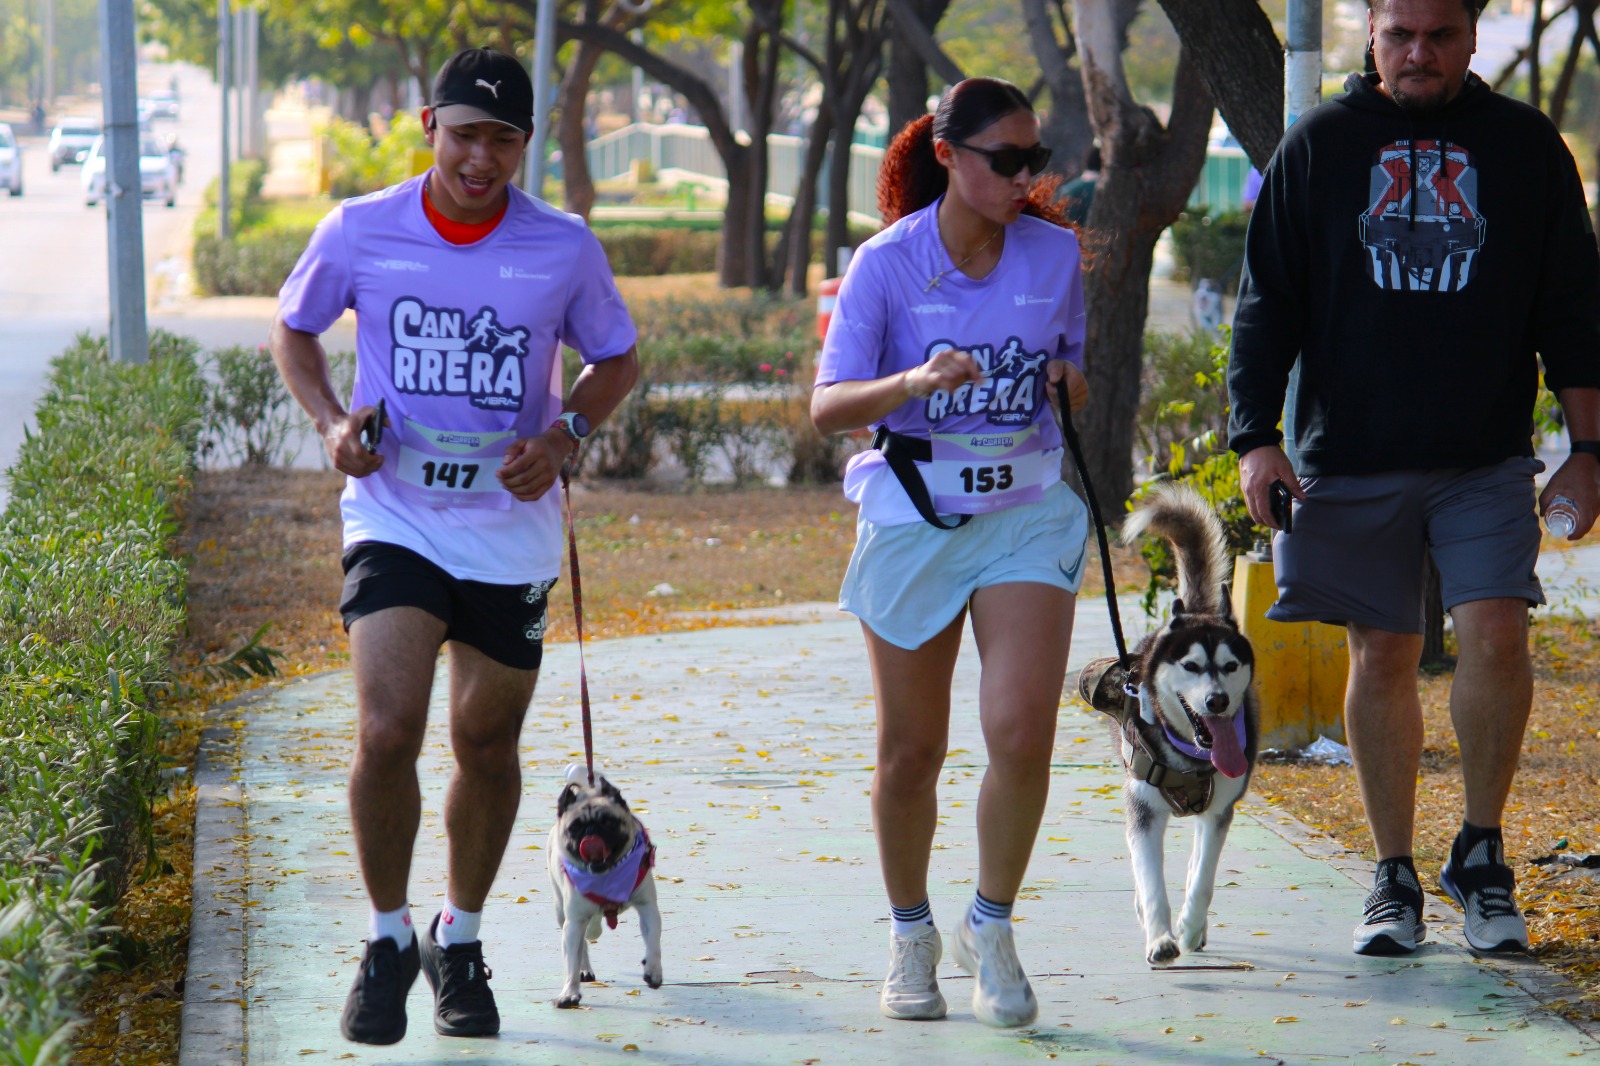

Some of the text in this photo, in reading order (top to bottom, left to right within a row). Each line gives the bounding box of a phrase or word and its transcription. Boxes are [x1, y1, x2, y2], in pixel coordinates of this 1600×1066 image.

[393, 300, 466, 351] CAN
[394, 347, 522, 397] RRERA
[474, 396, 519, 407] VIBRA
[928, 375, 1035, 420] RRERA
[991, 413, 1030, 421] VIBRA
[421, 461, 479, 489] 147
[959, 464, 1014, 493] 153
